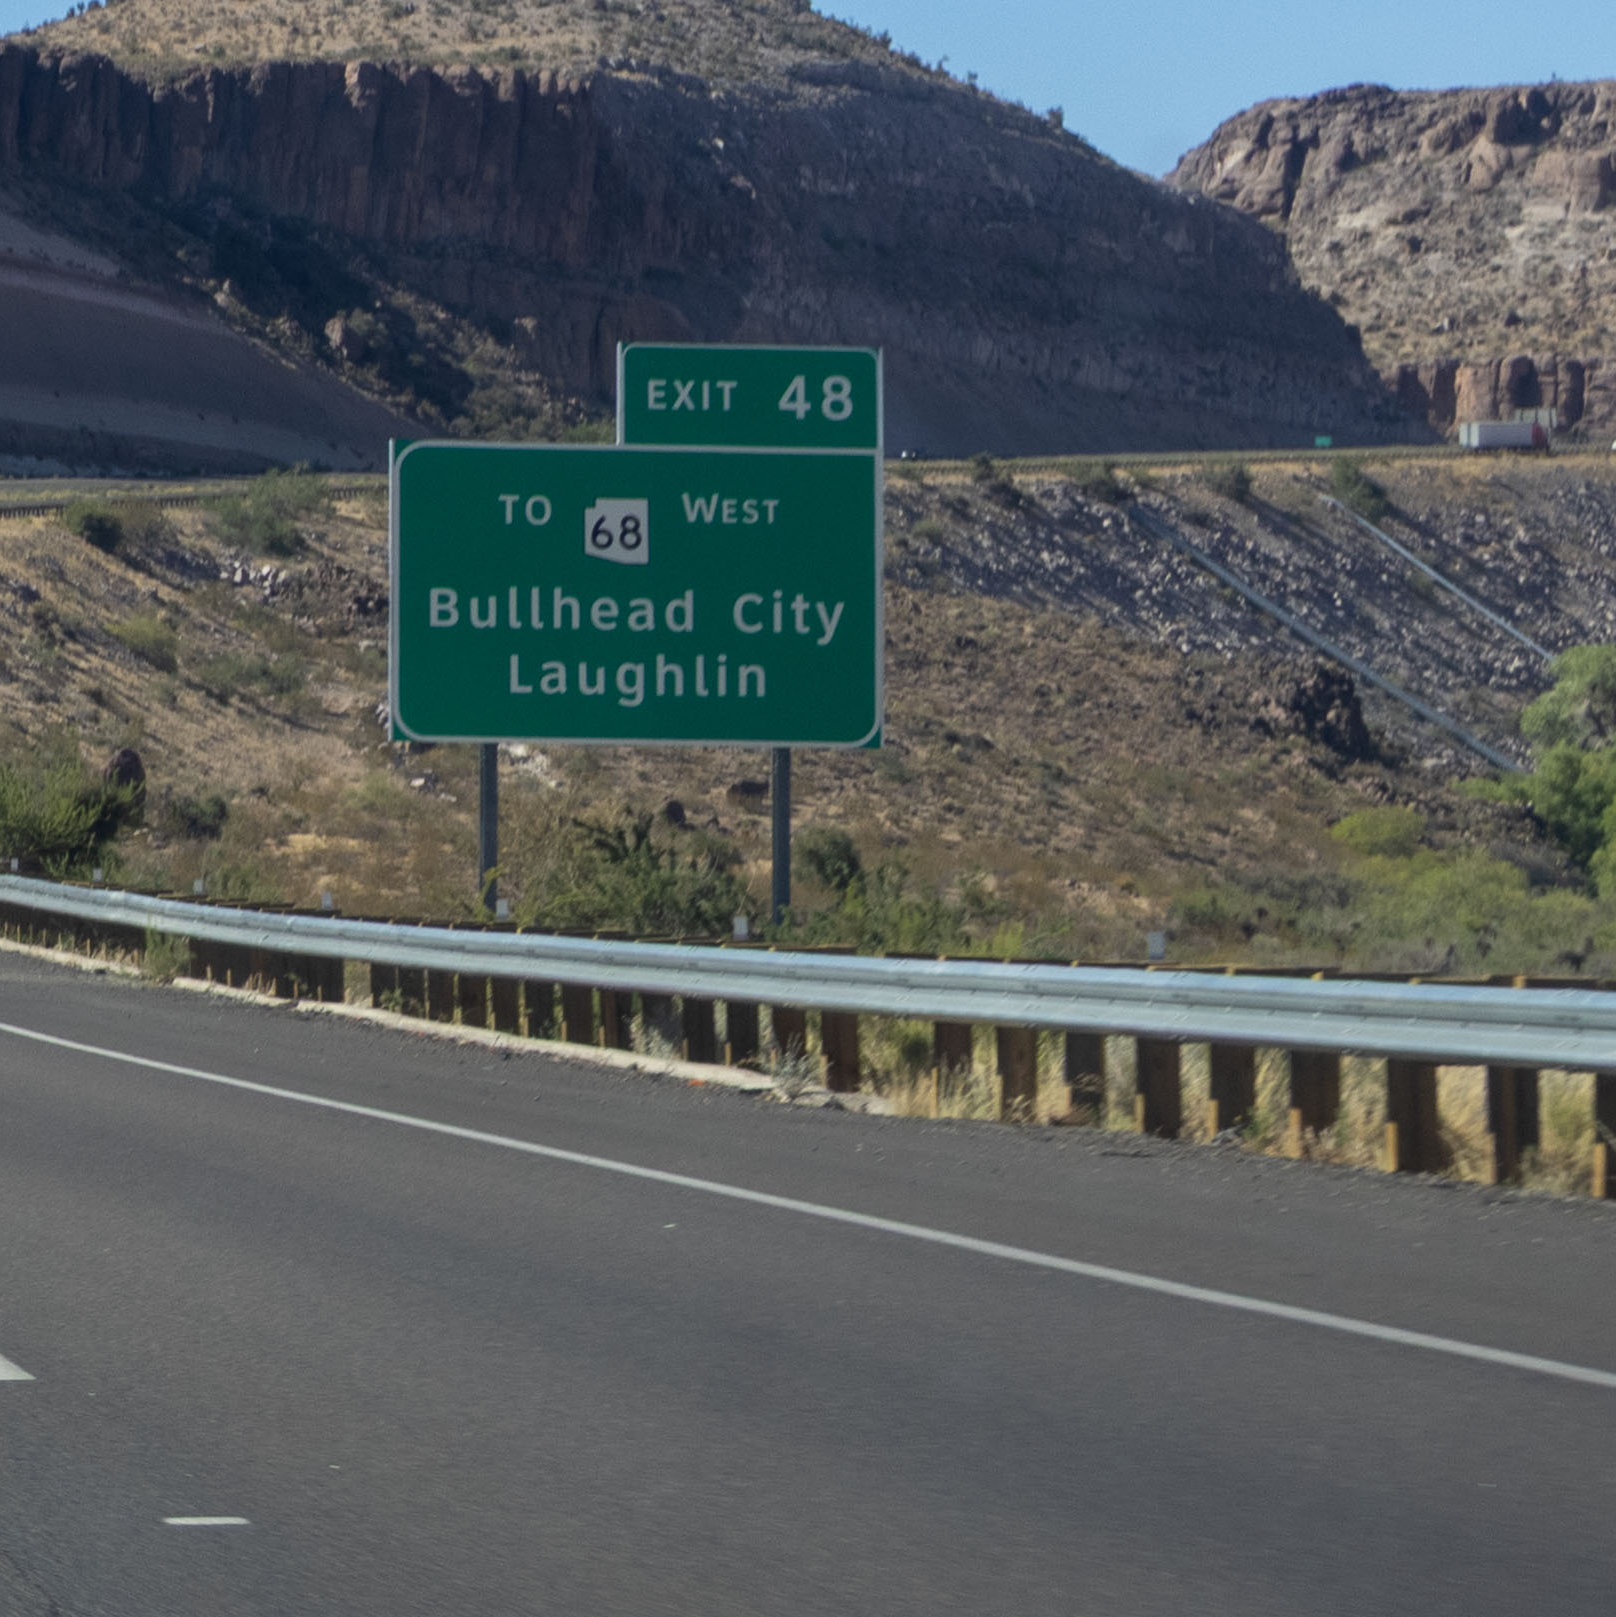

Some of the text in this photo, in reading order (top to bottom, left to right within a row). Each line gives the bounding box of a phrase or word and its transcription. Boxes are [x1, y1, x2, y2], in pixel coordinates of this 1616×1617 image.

[647, 375, 854, 421] EXIT 48
[498, 492, 779, 551] TO 68 WEST
[428, 586, 845, 646] Bullhead City
[509, 654, 767, 708] Laughlin
